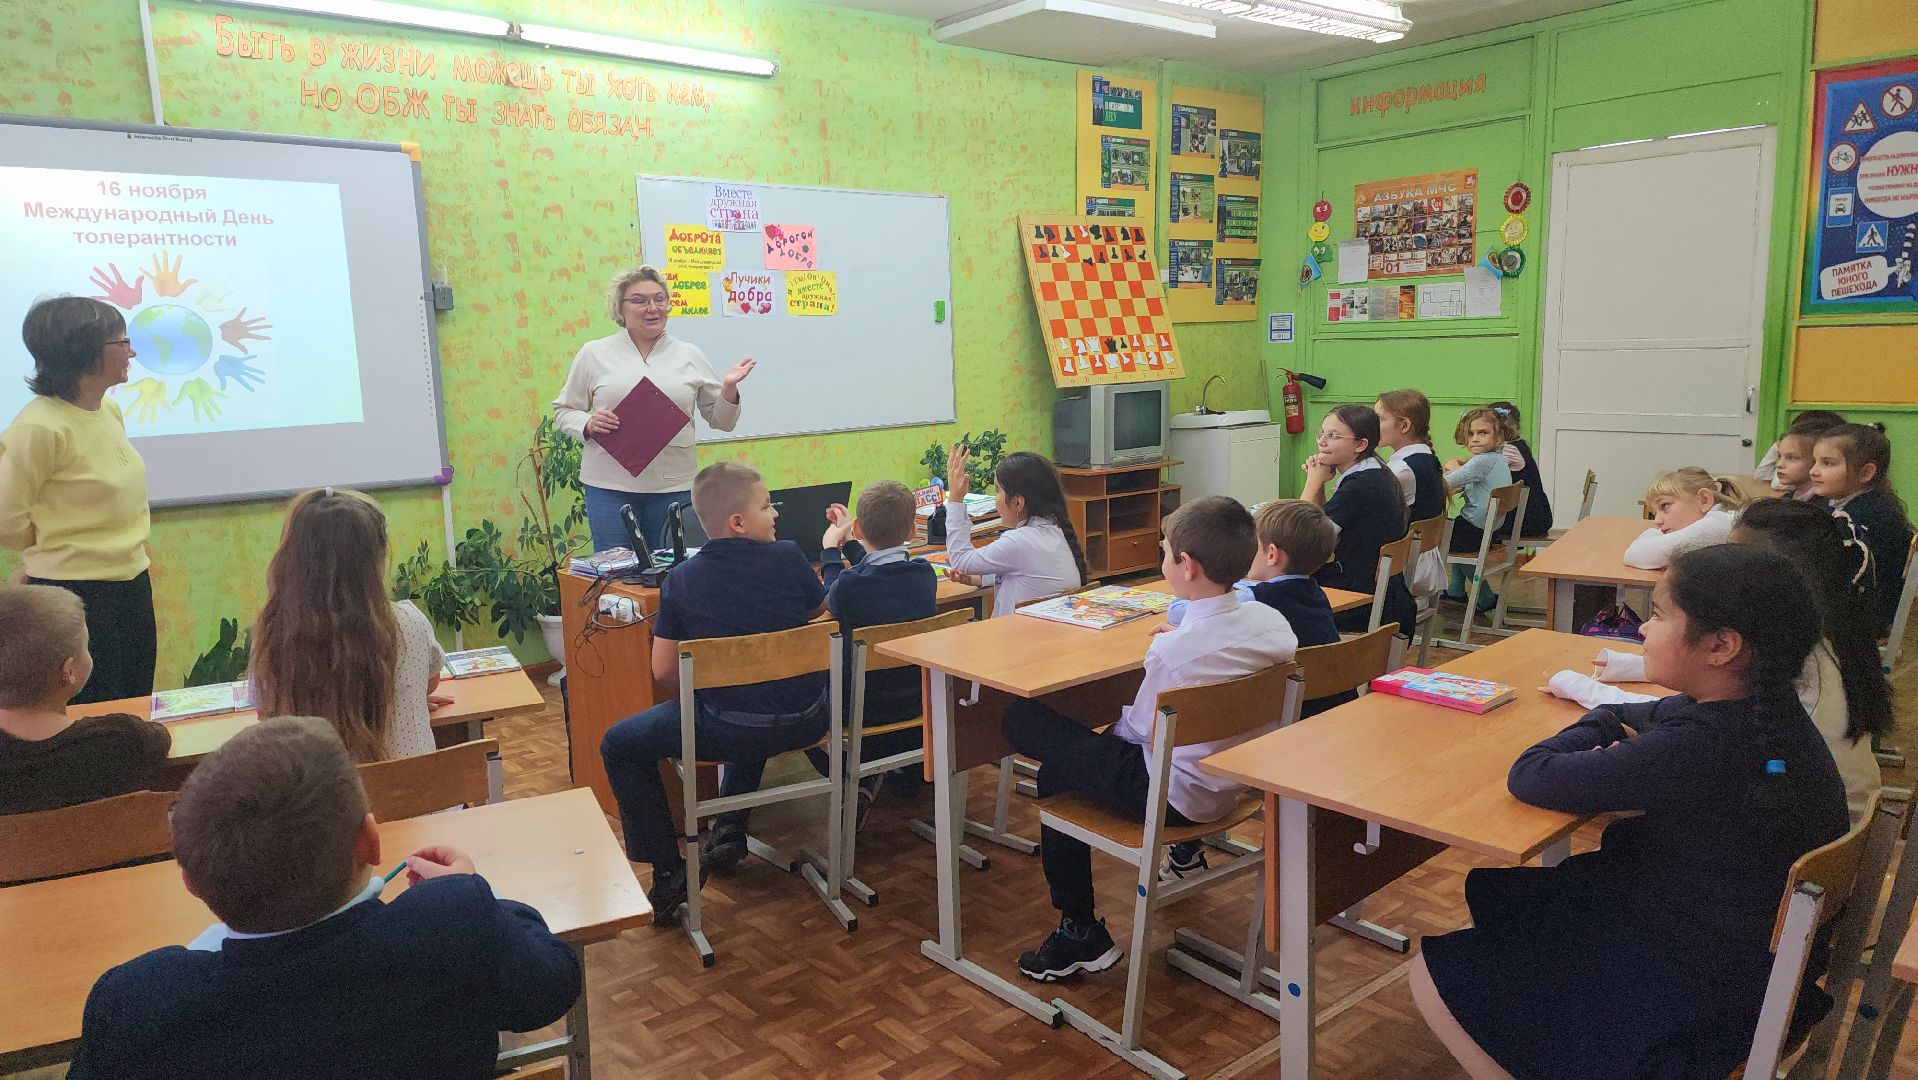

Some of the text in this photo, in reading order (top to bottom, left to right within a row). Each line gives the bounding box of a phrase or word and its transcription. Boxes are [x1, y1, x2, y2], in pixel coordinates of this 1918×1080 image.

[357, 82, 431, 120] ОБЖ
[97, 180, 207, 202] 16 ноября
[715, 185, 753, 199] Вместе
[1374, 189, 1424, 202] АЗБУКА
[1426, 183, 1457, 196] МЧС
[710, 199, 757, 208] дружная
[23, 201, 275, 227] Международный День
[709, 208, 760, 222] страна
[72, 230, 237, 248] толерантности
[1386, 262, 1401, 273] 01
[1832, 261, 1873, 277] ПАМЯТКА
[731, 272, 771, 288] Лучики
[1837, 272, 1869, 286] ЮНОГО
[728, 286, 772, 306] добра
[1831, 281, 1878, 297] ПЕШЕХОДА
[789, 299, 835, 313] страна!
